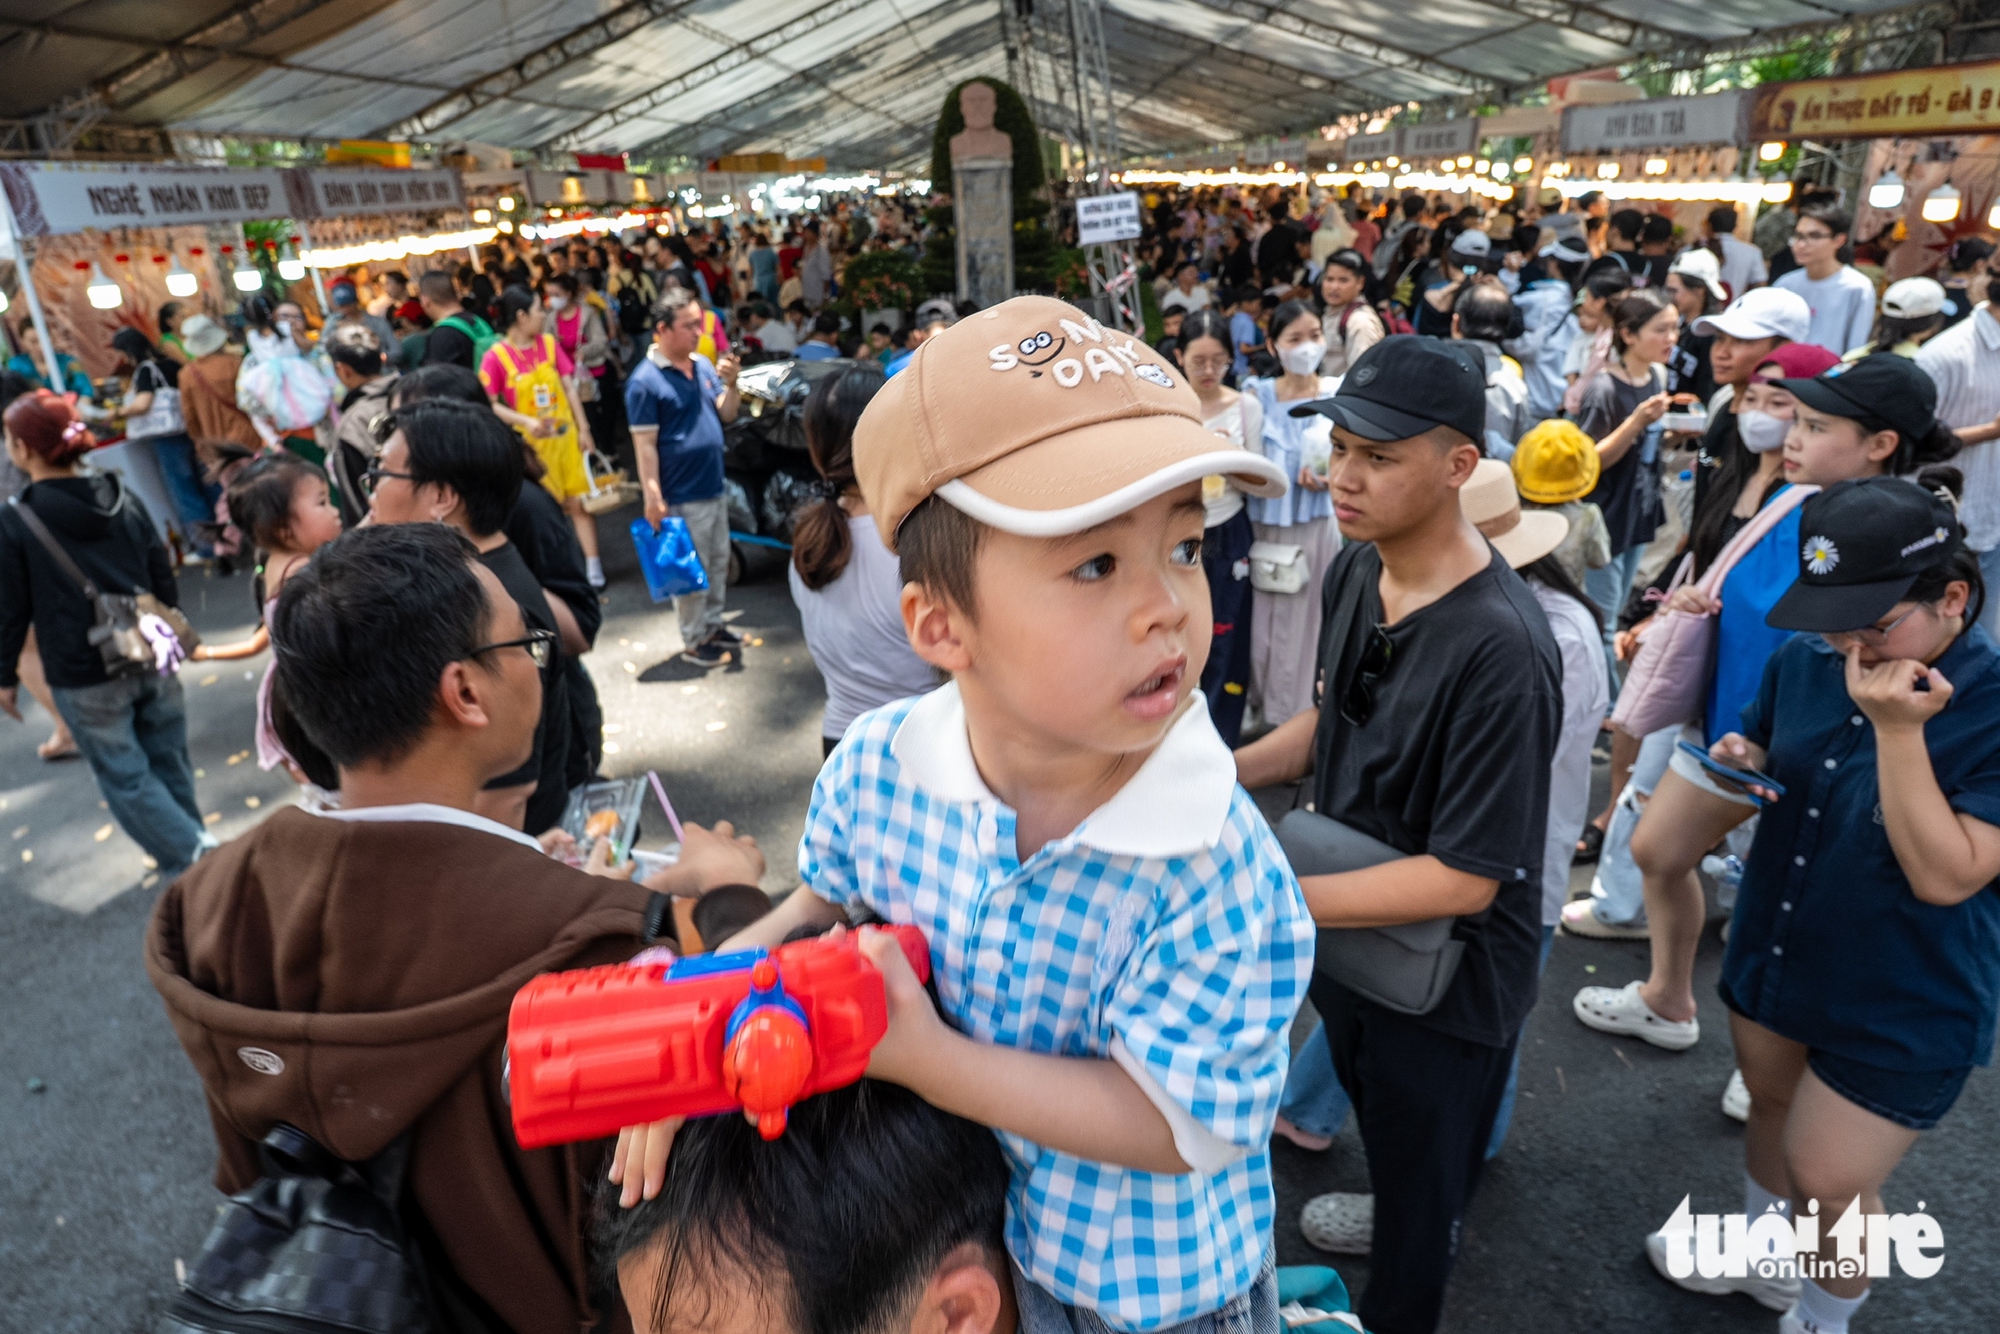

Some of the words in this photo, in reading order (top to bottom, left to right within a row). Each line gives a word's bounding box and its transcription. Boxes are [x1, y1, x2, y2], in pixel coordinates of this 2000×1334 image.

[87, 182, 145, 217] NGHỆ
[148, 182, 203, 214] NHÂN
[203, 185, 241, 212] KIM
